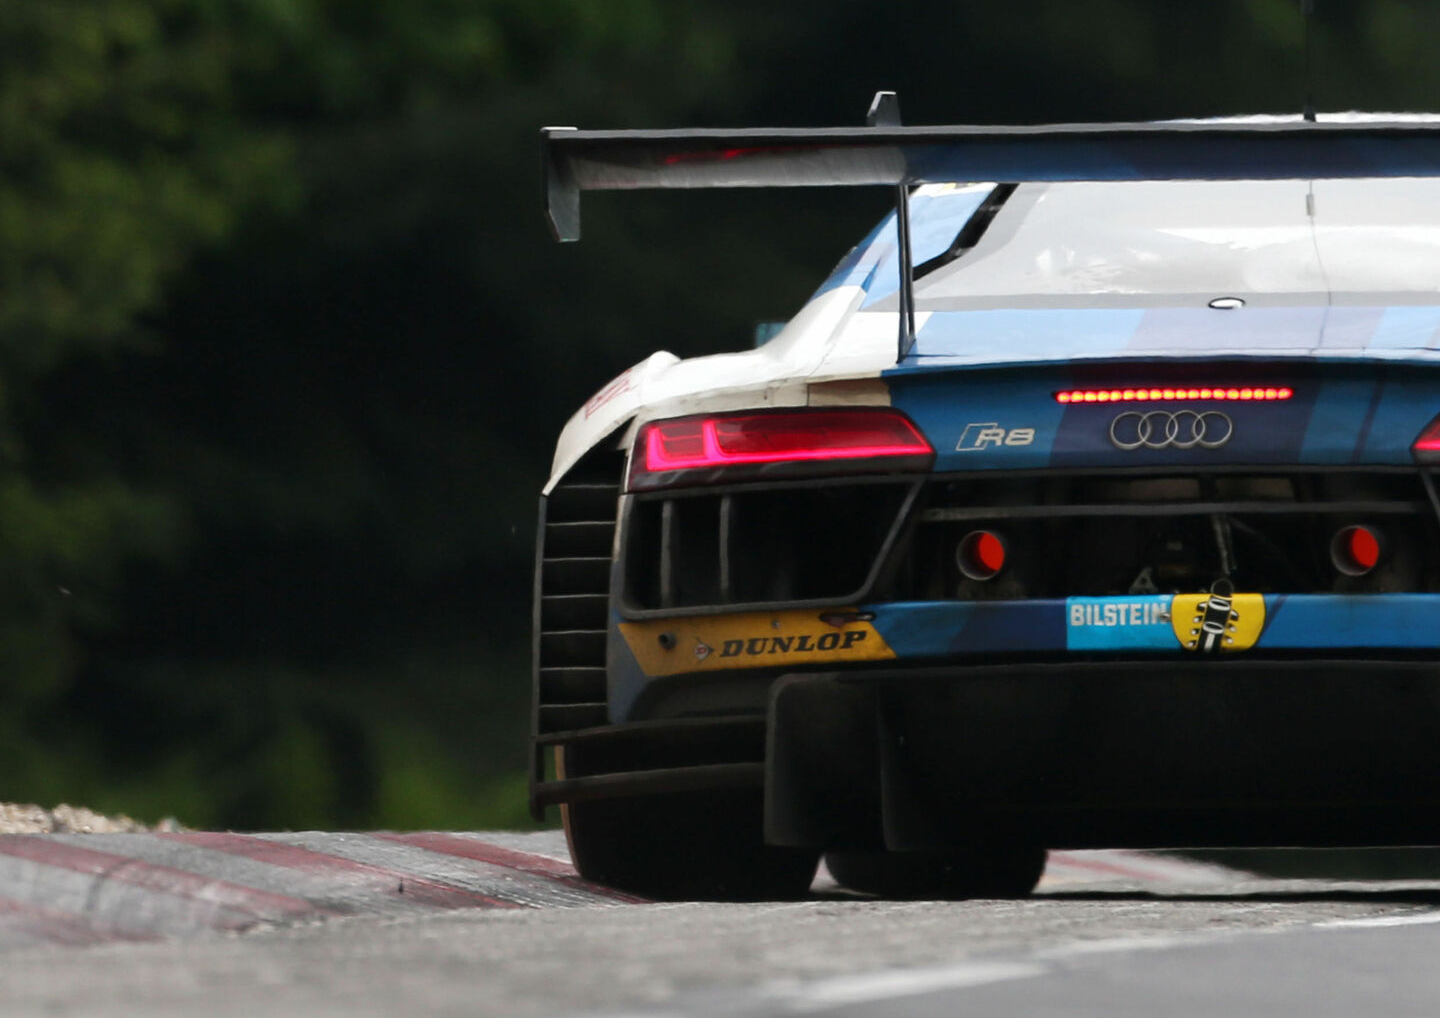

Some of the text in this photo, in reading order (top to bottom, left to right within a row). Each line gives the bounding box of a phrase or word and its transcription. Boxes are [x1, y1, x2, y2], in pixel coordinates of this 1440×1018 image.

[970, 427, 1036, 447] R8
[1070, 602, 1169, 627] BILSTEIN
[719, 630, 868, 658] DUNLOP
